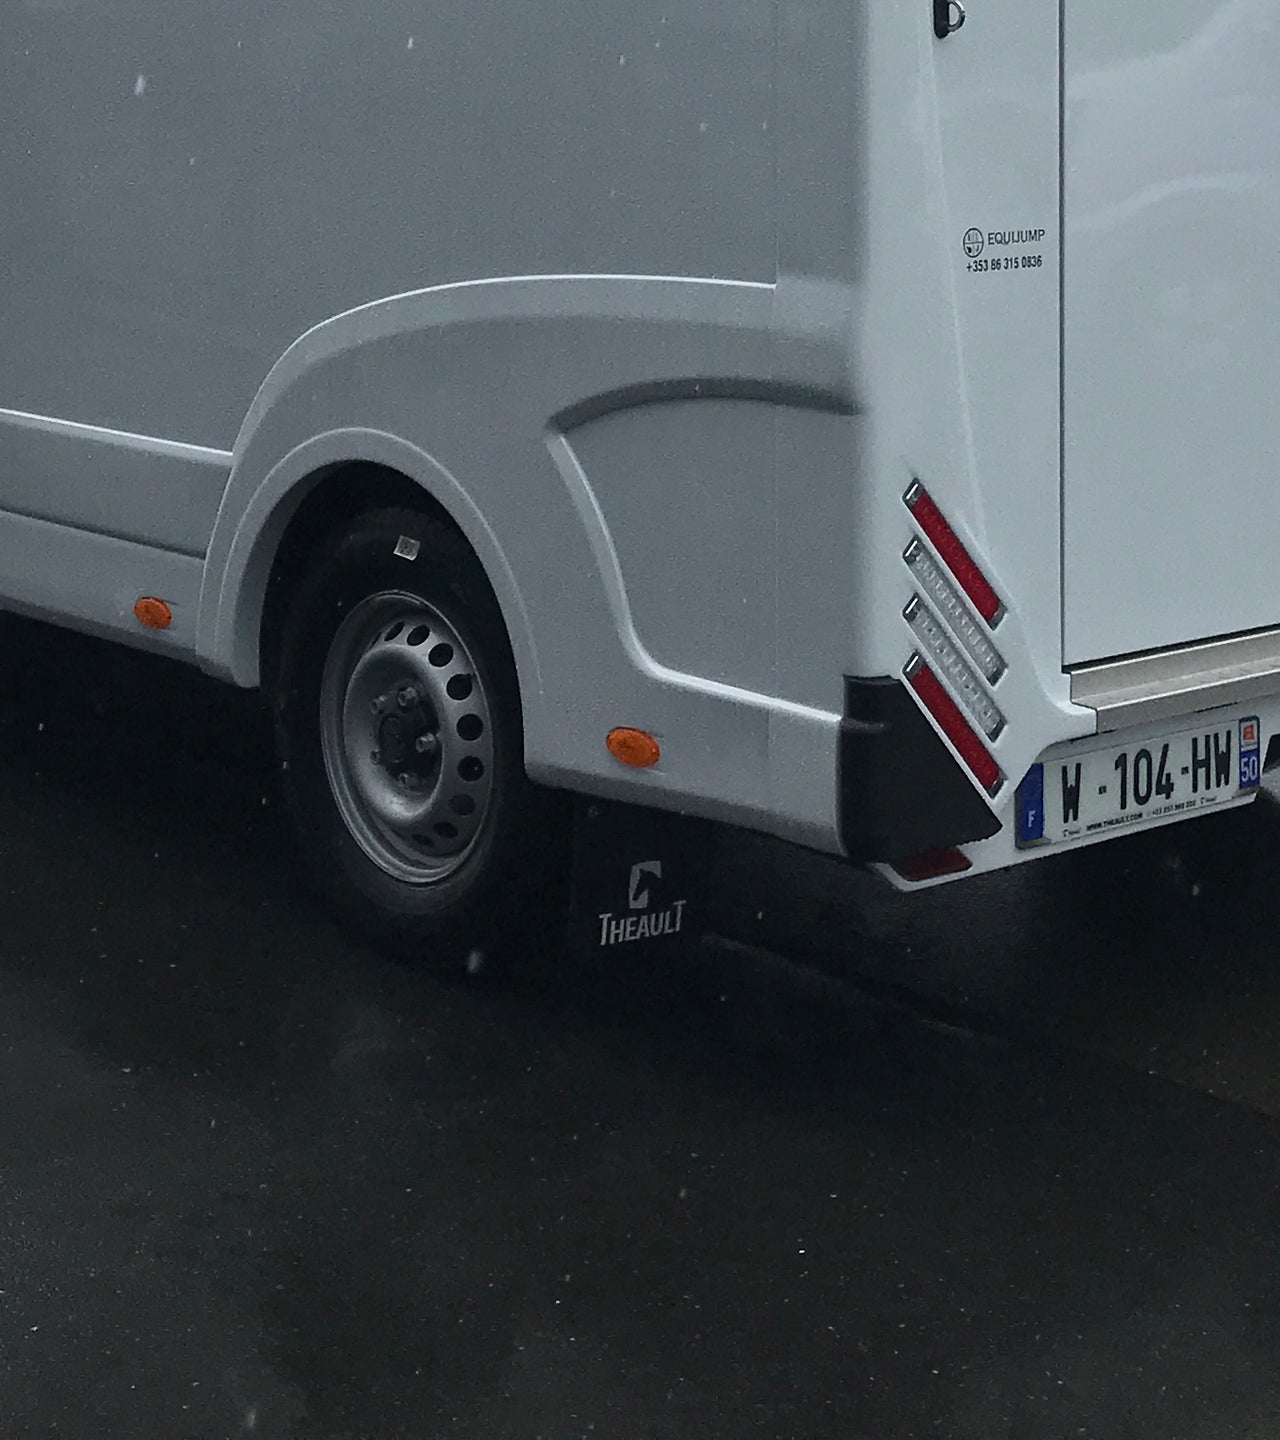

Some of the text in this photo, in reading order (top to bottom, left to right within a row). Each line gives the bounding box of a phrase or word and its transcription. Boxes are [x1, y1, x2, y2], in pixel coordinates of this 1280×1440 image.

[987, 229, 1045, 245] EQUIJUMP
[966, 259, 988, 272] +353
[1004, 257, 1019, 269] 315
[1240, 757, 1258, 782] 50
[1027, 810, 1035, 828] F
[599, 900, 686, 946] THEAULT
